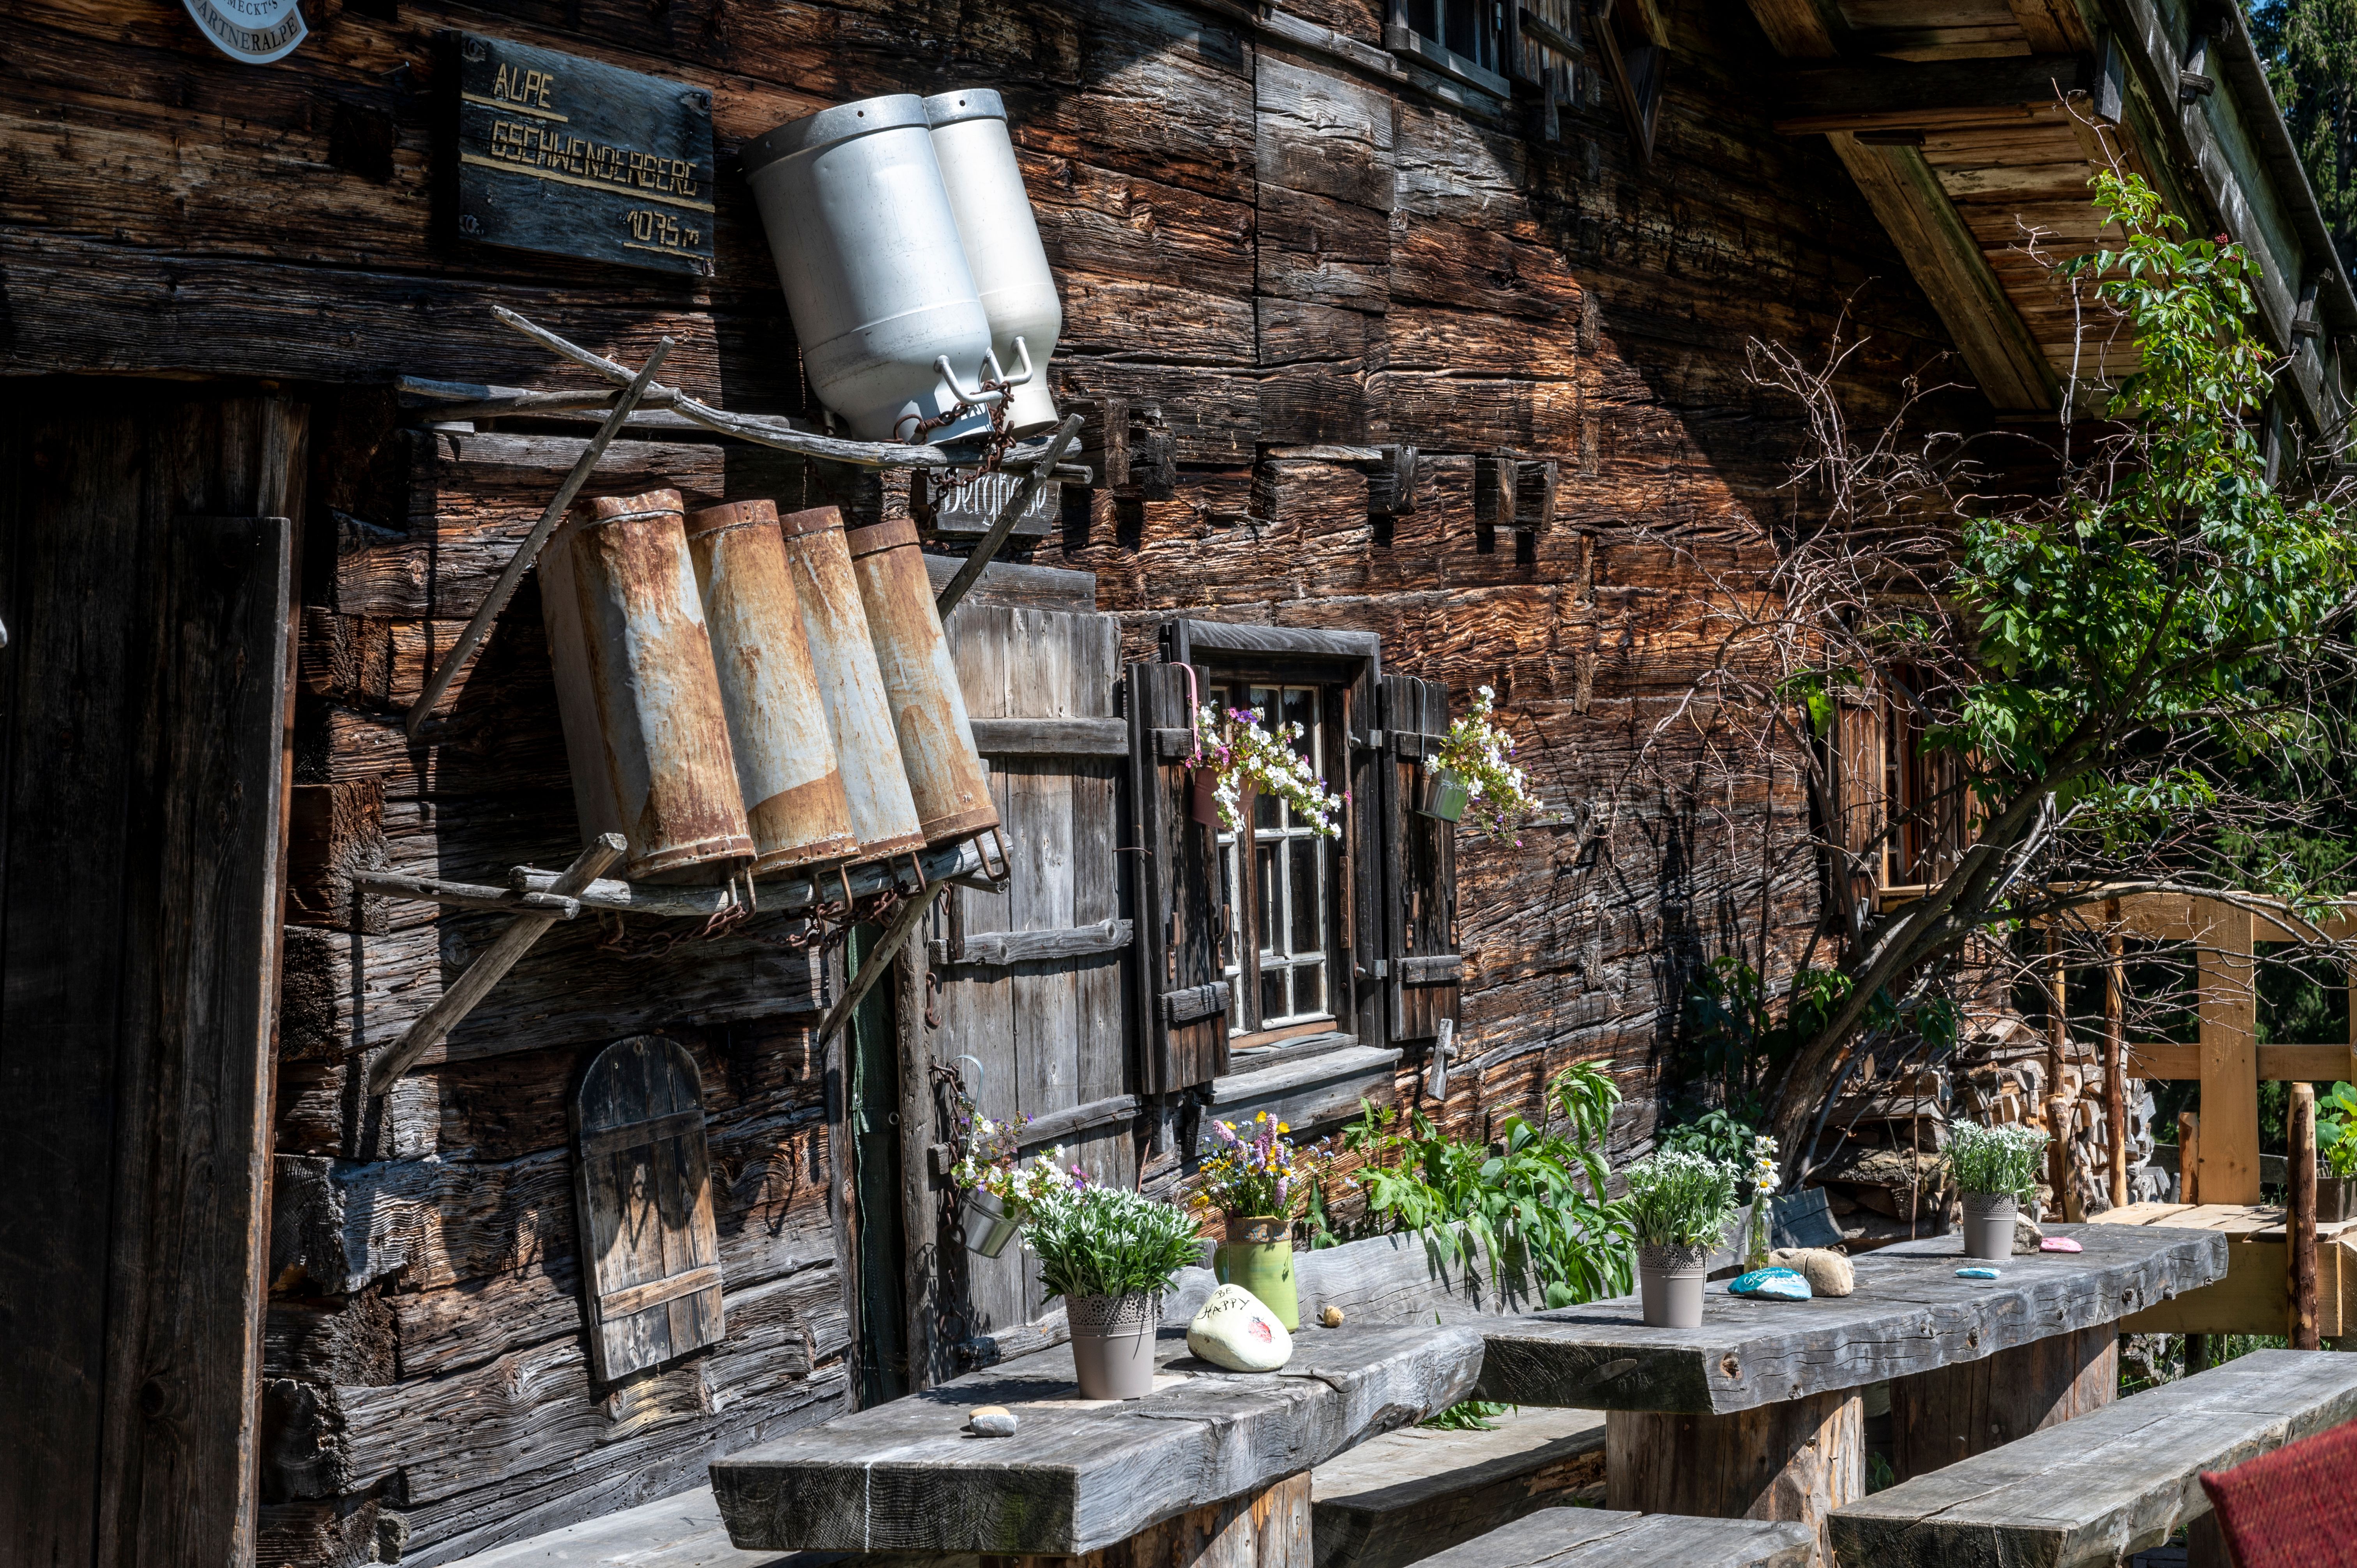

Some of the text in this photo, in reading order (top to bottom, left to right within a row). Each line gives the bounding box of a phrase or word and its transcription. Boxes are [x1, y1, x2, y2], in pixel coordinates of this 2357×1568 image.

[193, 0, 297, 51] ARTNERALPE
[493, 63, 553, 109] ALPE
[491, 120, 697, 196] GSCHWENDERBERG
[627, 208, 699, 247] 1075 m
[1197, 1297, 1250, 1320] HAPPY
[1214, 1287, 1233, 1299] BE
